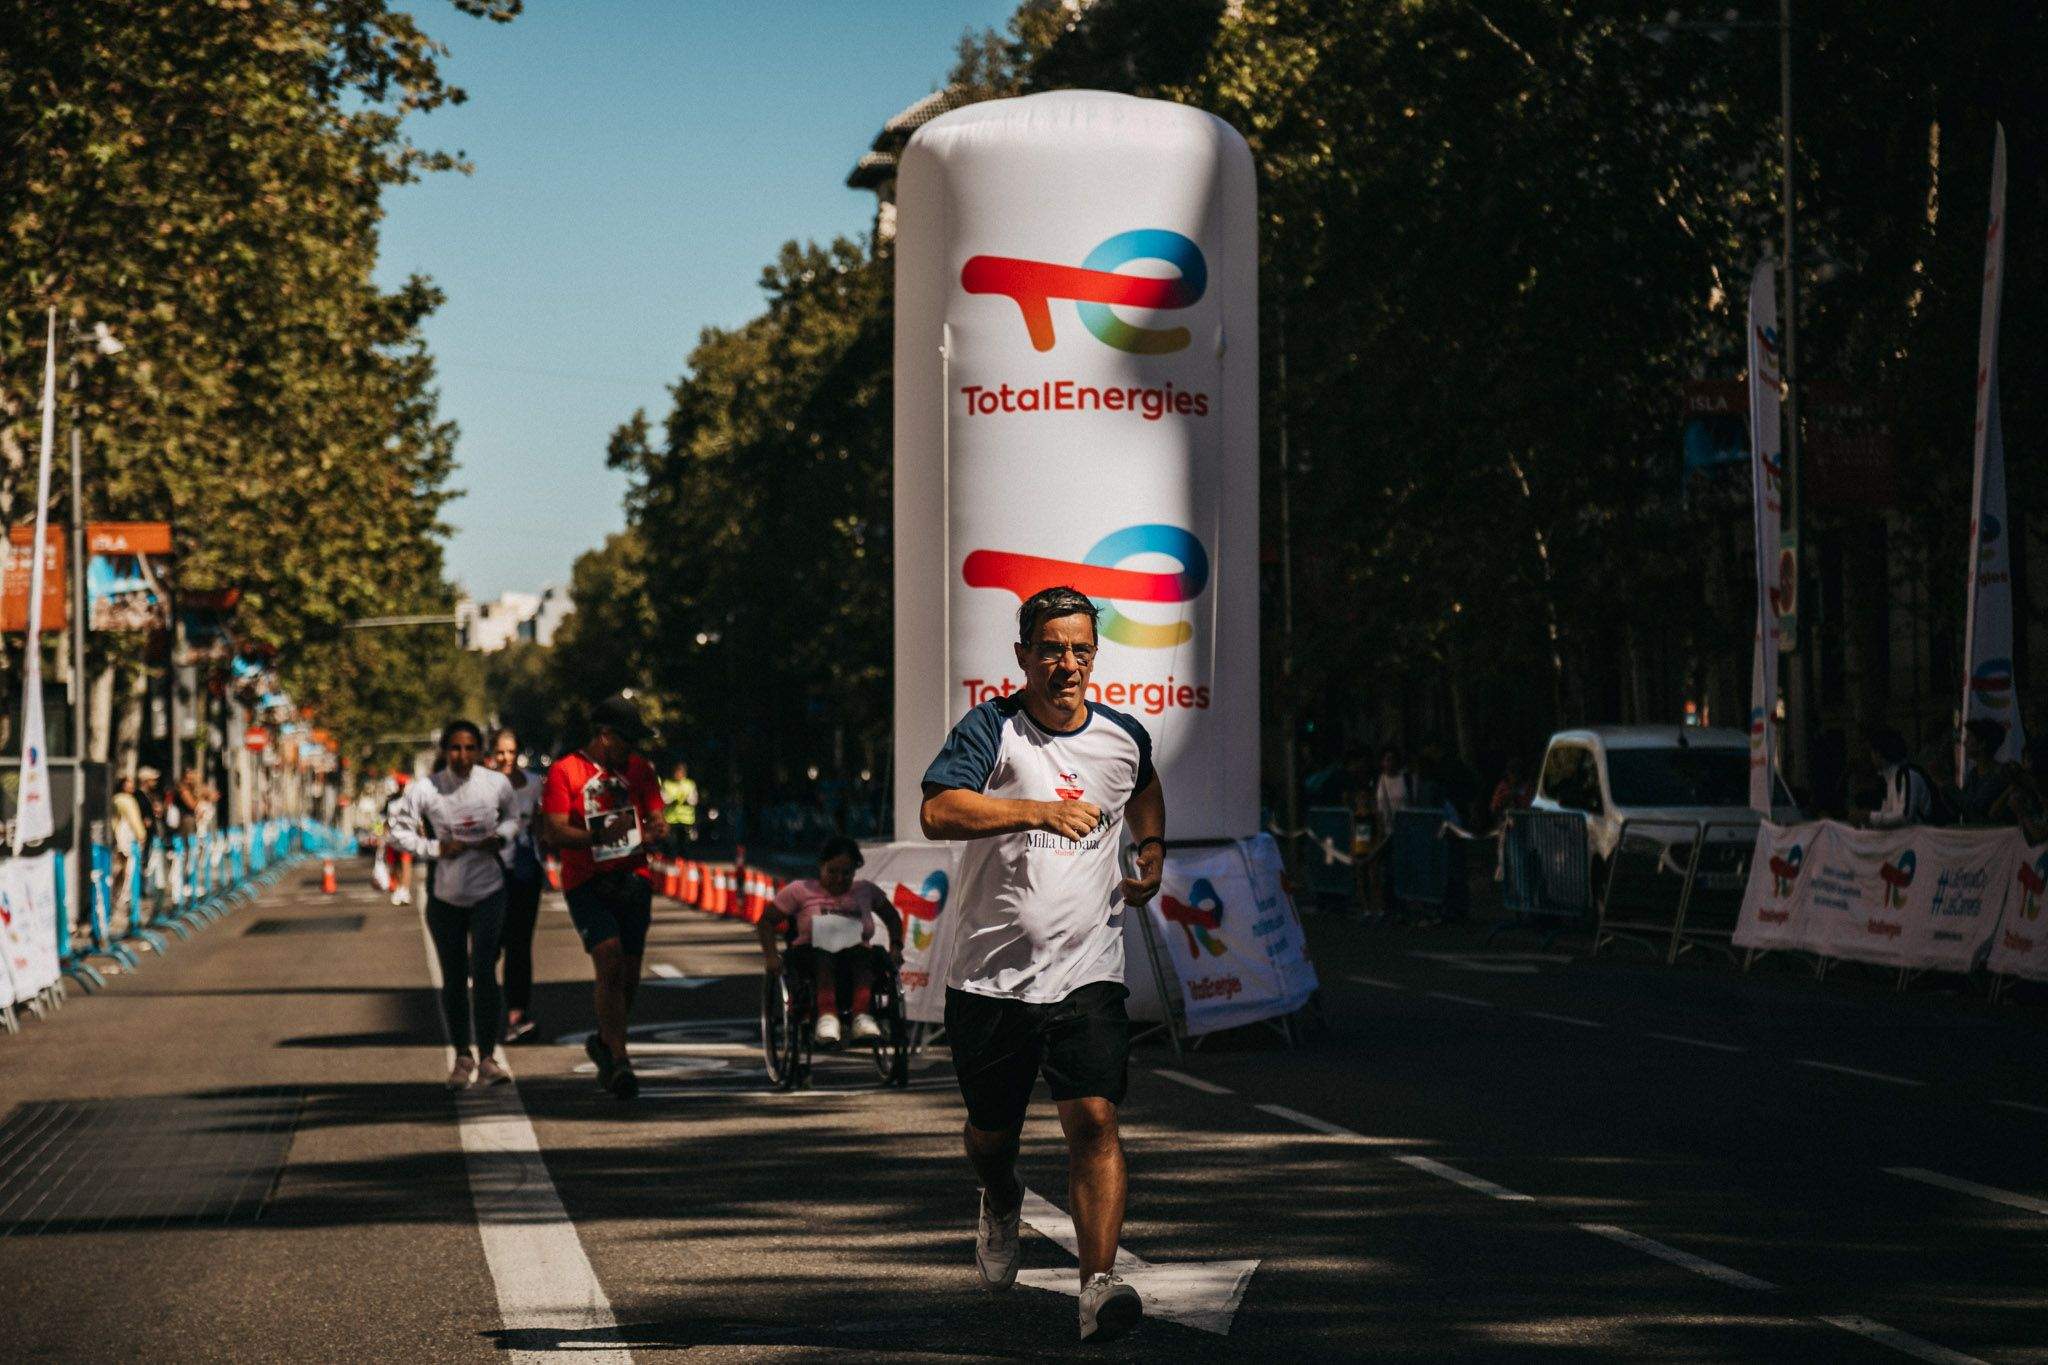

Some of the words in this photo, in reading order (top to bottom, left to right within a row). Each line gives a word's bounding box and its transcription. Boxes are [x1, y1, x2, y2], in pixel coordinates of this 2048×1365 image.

[961, 381, 1209, 420] TotalEnergies
[963, 677, 1210, 715] Totnergies
[1025, 832, 1056, 849] Milla
